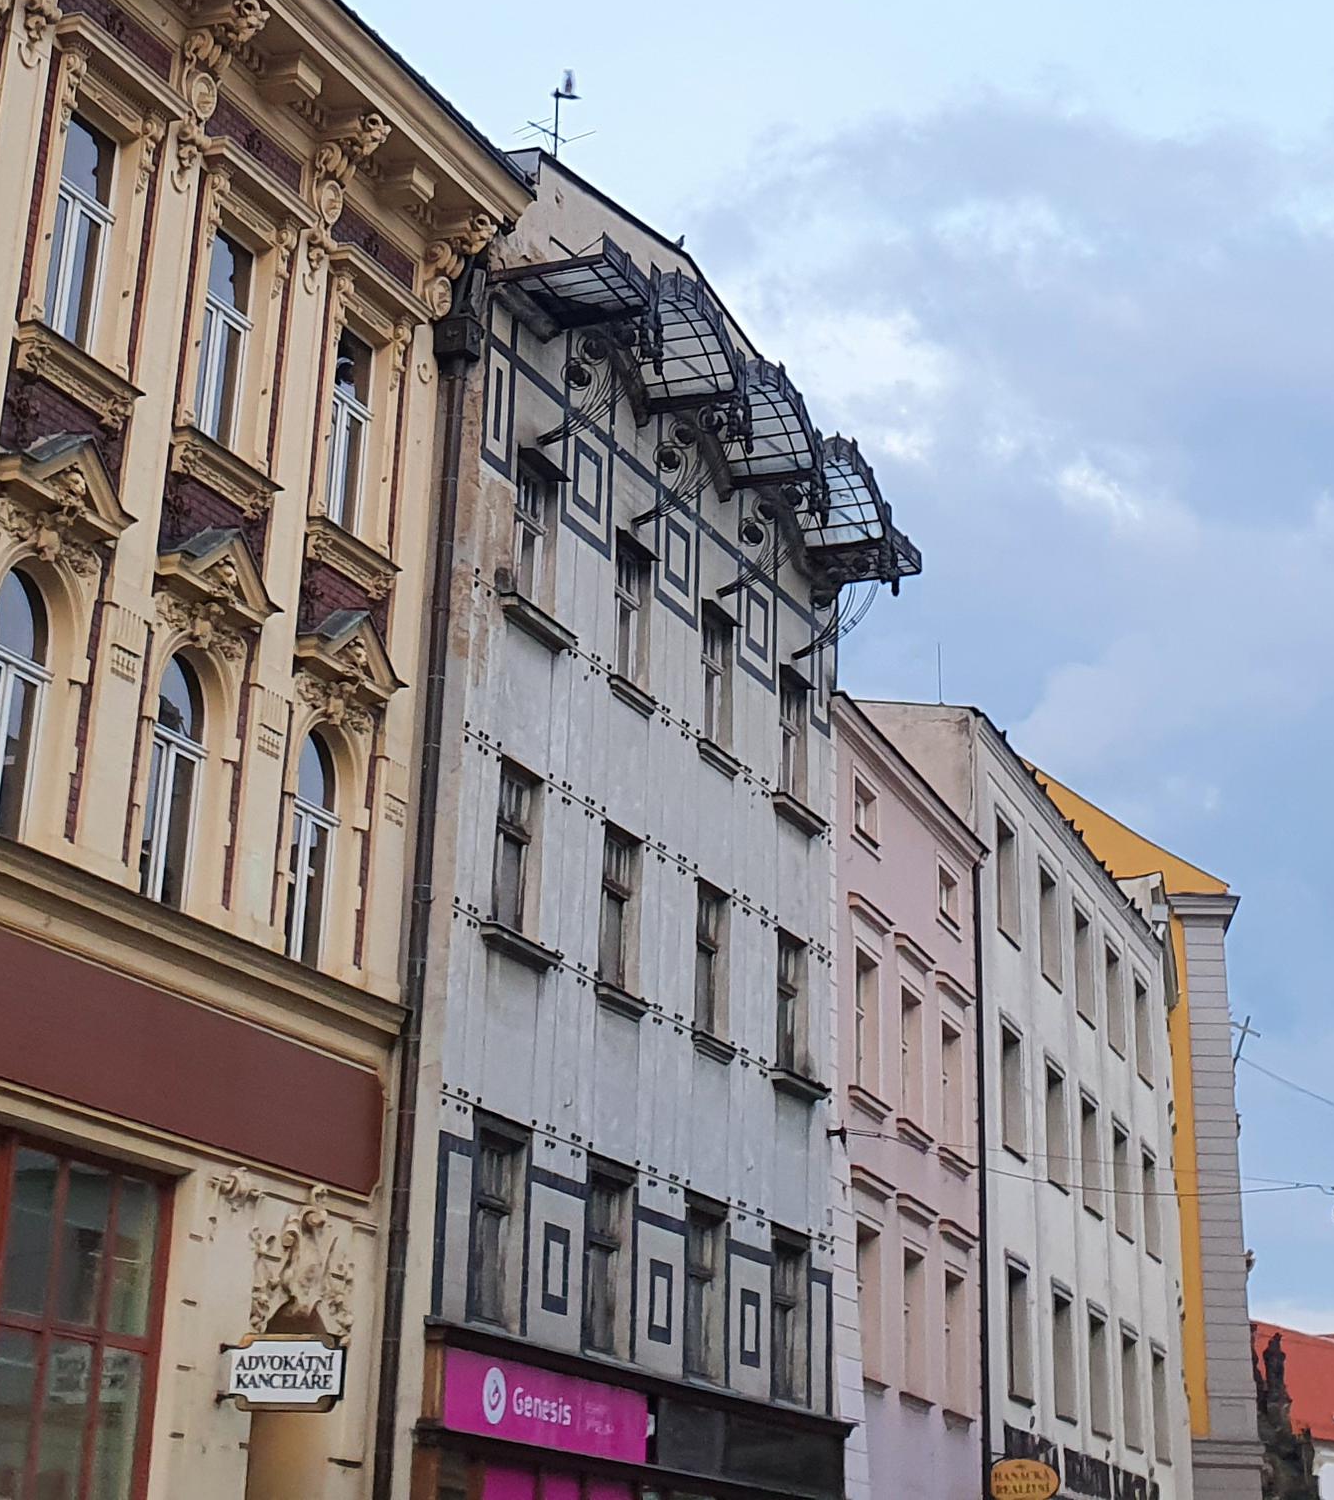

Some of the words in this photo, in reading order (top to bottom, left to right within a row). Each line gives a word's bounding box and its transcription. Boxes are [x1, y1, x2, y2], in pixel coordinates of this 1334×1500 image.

[234, 1351, 335, 1371] ADVOKÁTNÍ
[234, 1369, 333, 1390] KANCELÁŘE
[512, 1387, 572, 1426] Genesis
